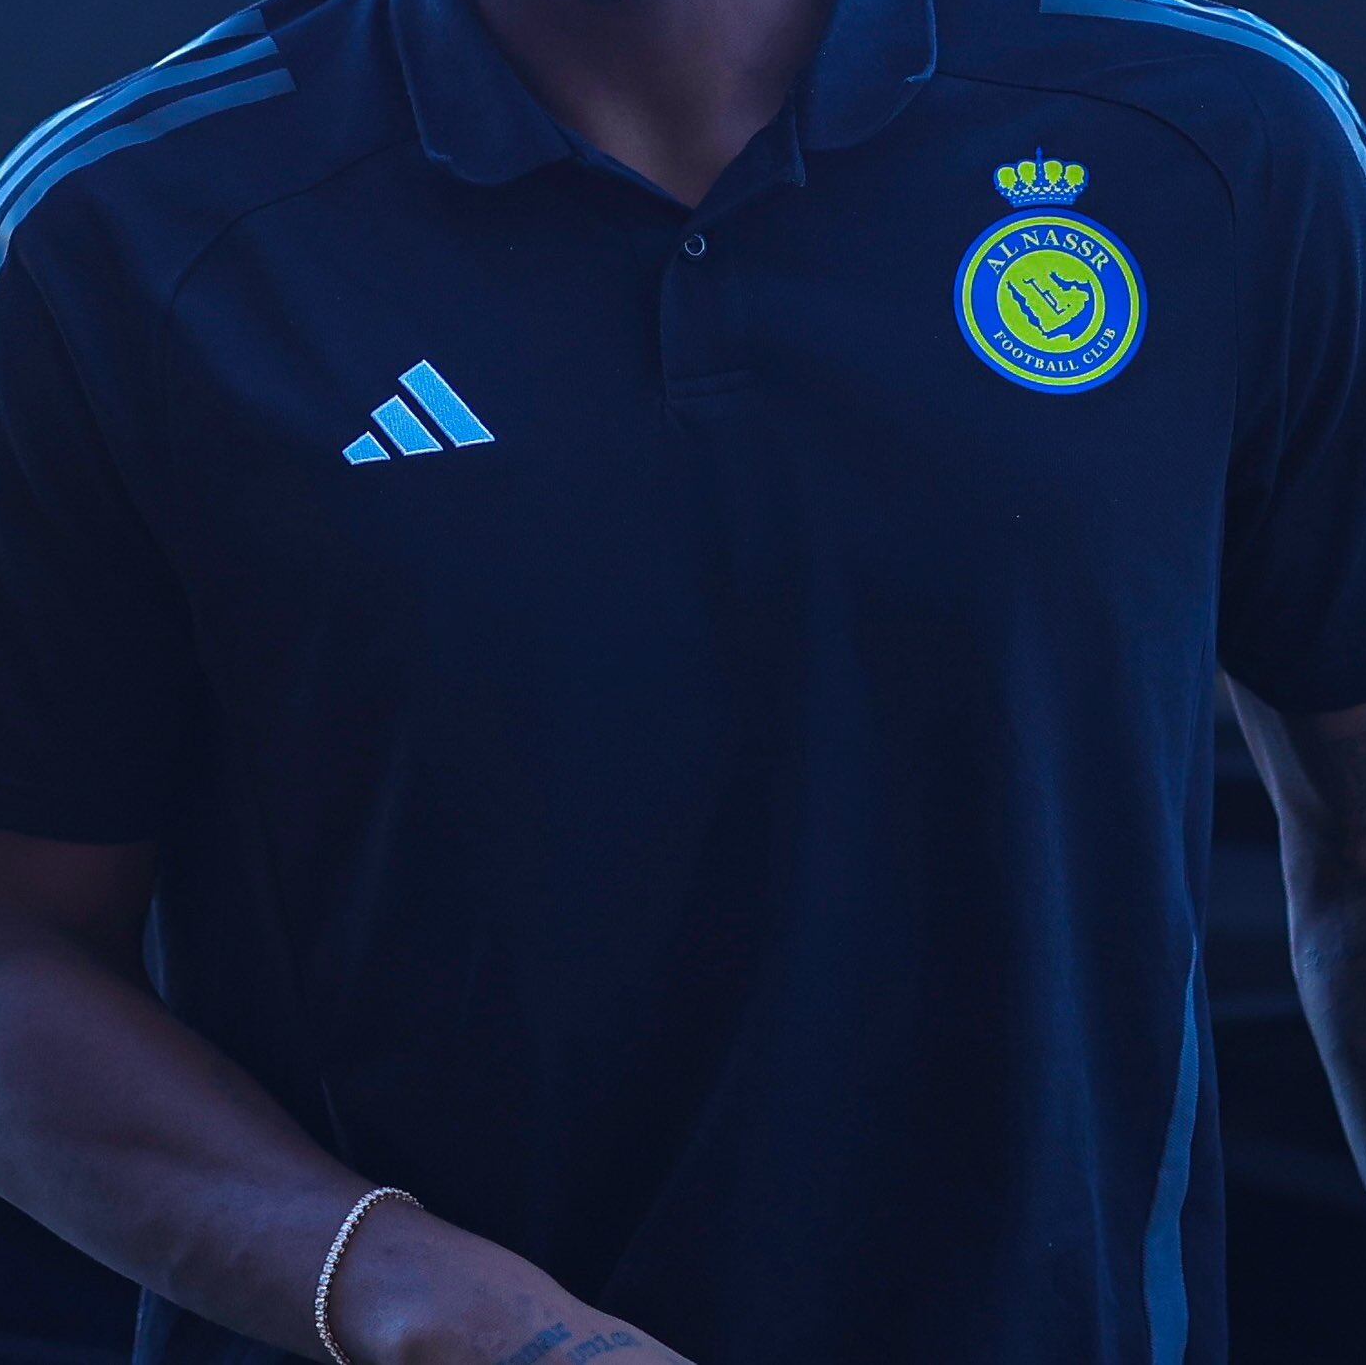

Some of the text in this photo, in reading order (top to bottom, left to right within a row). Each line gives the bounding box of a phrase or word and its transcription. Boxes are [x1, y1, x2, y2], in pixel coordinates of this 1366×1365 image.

[986, 229, 1110, 274] AL NASSR
[992, 327, 1116, 372] FOOTBALL CLUB
